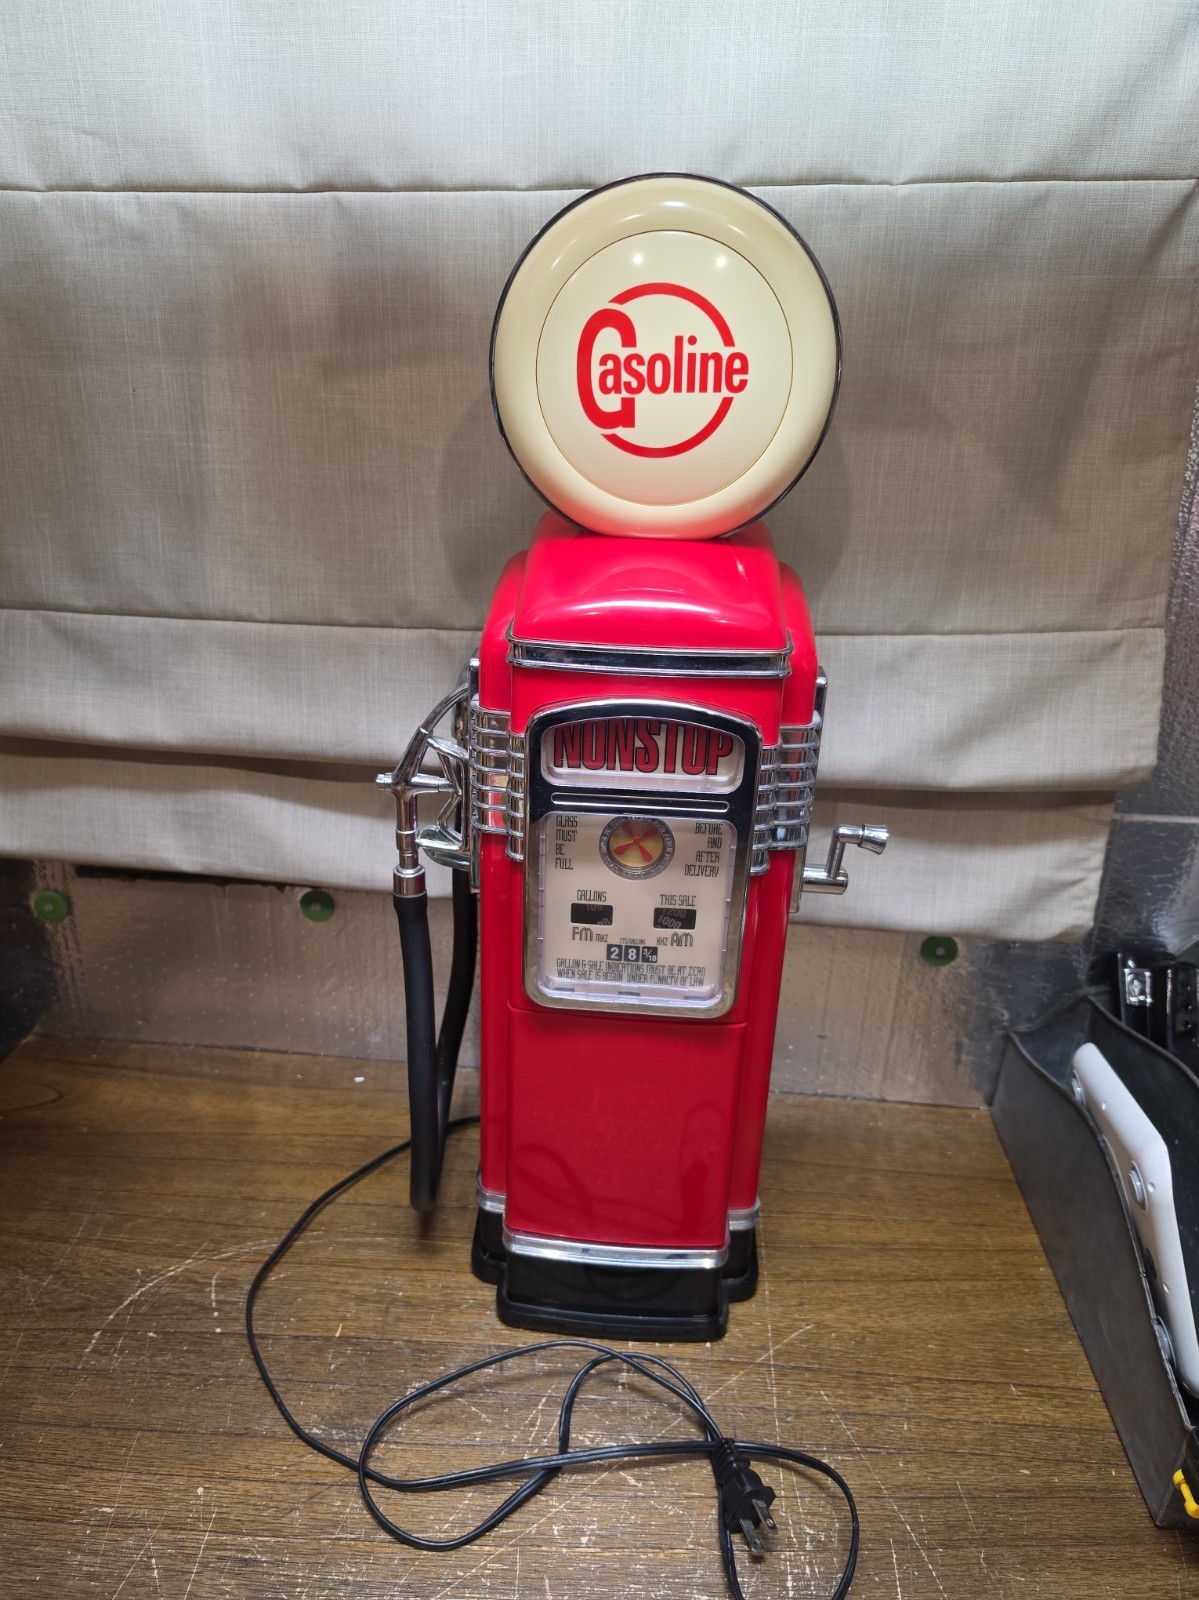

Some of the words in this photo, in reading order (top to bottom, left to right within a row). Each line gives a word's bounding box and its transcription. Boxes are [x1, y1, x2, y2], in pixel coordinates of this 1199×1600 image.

[576, 308, 749, 430] Gasoline
[553, 718, 734, 776] NONSTOP
[556, 815, 578, 828] GLASS
[695, 822, 723, 835] BEFORE
[556, 830, 577, 842] MUST
[707, 837, 722, 849] AND
[555, 844, 565, 856] BE
[554, 858, 574, 870] FULL
[696, 851, 720, 864] AFTER
[684, 865, 719, 878] DELIVERY
[577, 889, 607, 903] GALLONS
[660, 894, 677, 906] THIS
[678, 895, 697, 907] SALE
[572, 926, 594, 942] FM
[670, 932, 694, 947] AM
[610, 947, 619, 959] 2
[627, 948, 637, 960] 8
[556, 957, 581, 969] GALLON
[588, 960, 604, 971] SALE
[605, 961, 645, 974] INDICATIONS
[646, 963, 666, 975] MUST
[677, 965, 687, 976] AT
[688, 966, 706, 977] ZERO
[557, 968, 576, 978] WHEN
[577, 969, 593, 980] SALE
[626, 972, 648, 984] UNDER
[680, 976, 689, 986] OF
[690, 977, 705, 987] LAW
